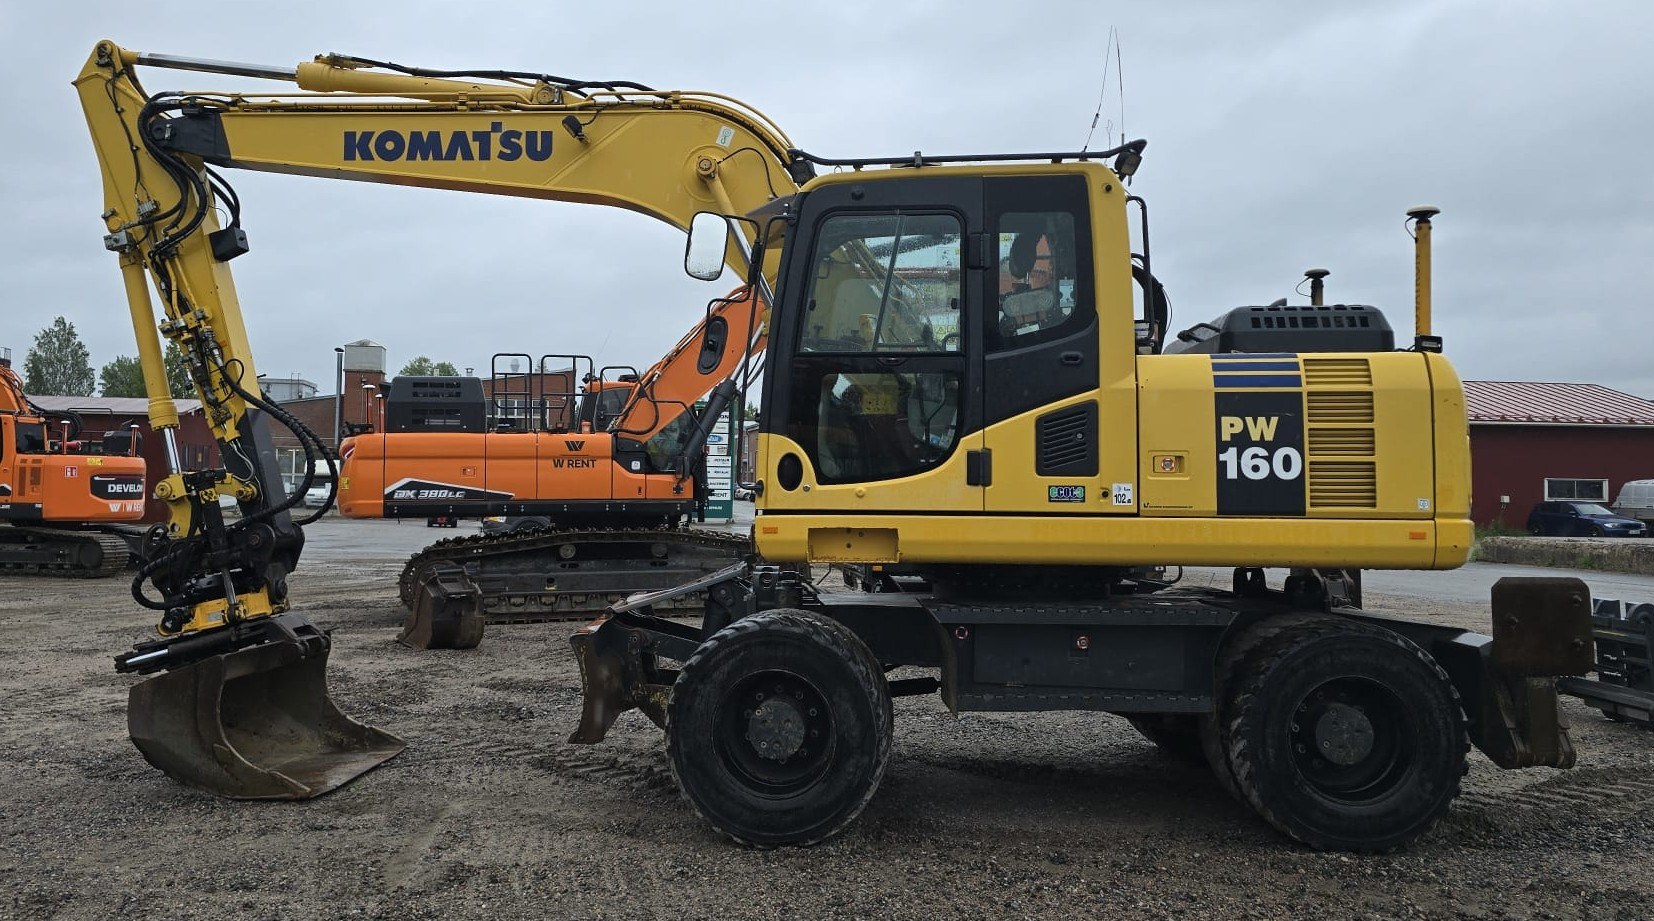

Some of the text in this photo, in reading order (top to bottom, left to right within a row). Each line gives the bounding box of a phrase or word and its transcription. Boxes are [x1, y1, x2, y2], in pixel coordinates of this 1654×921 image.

[344, 121, 553, 161] KOMATSU
[1221, 416, 1279, 441] PW
[553, 458, 597, 468] W RENT
[1219, 446, 1302, 480] 160
[1113, 493, 1126, 504] 102
